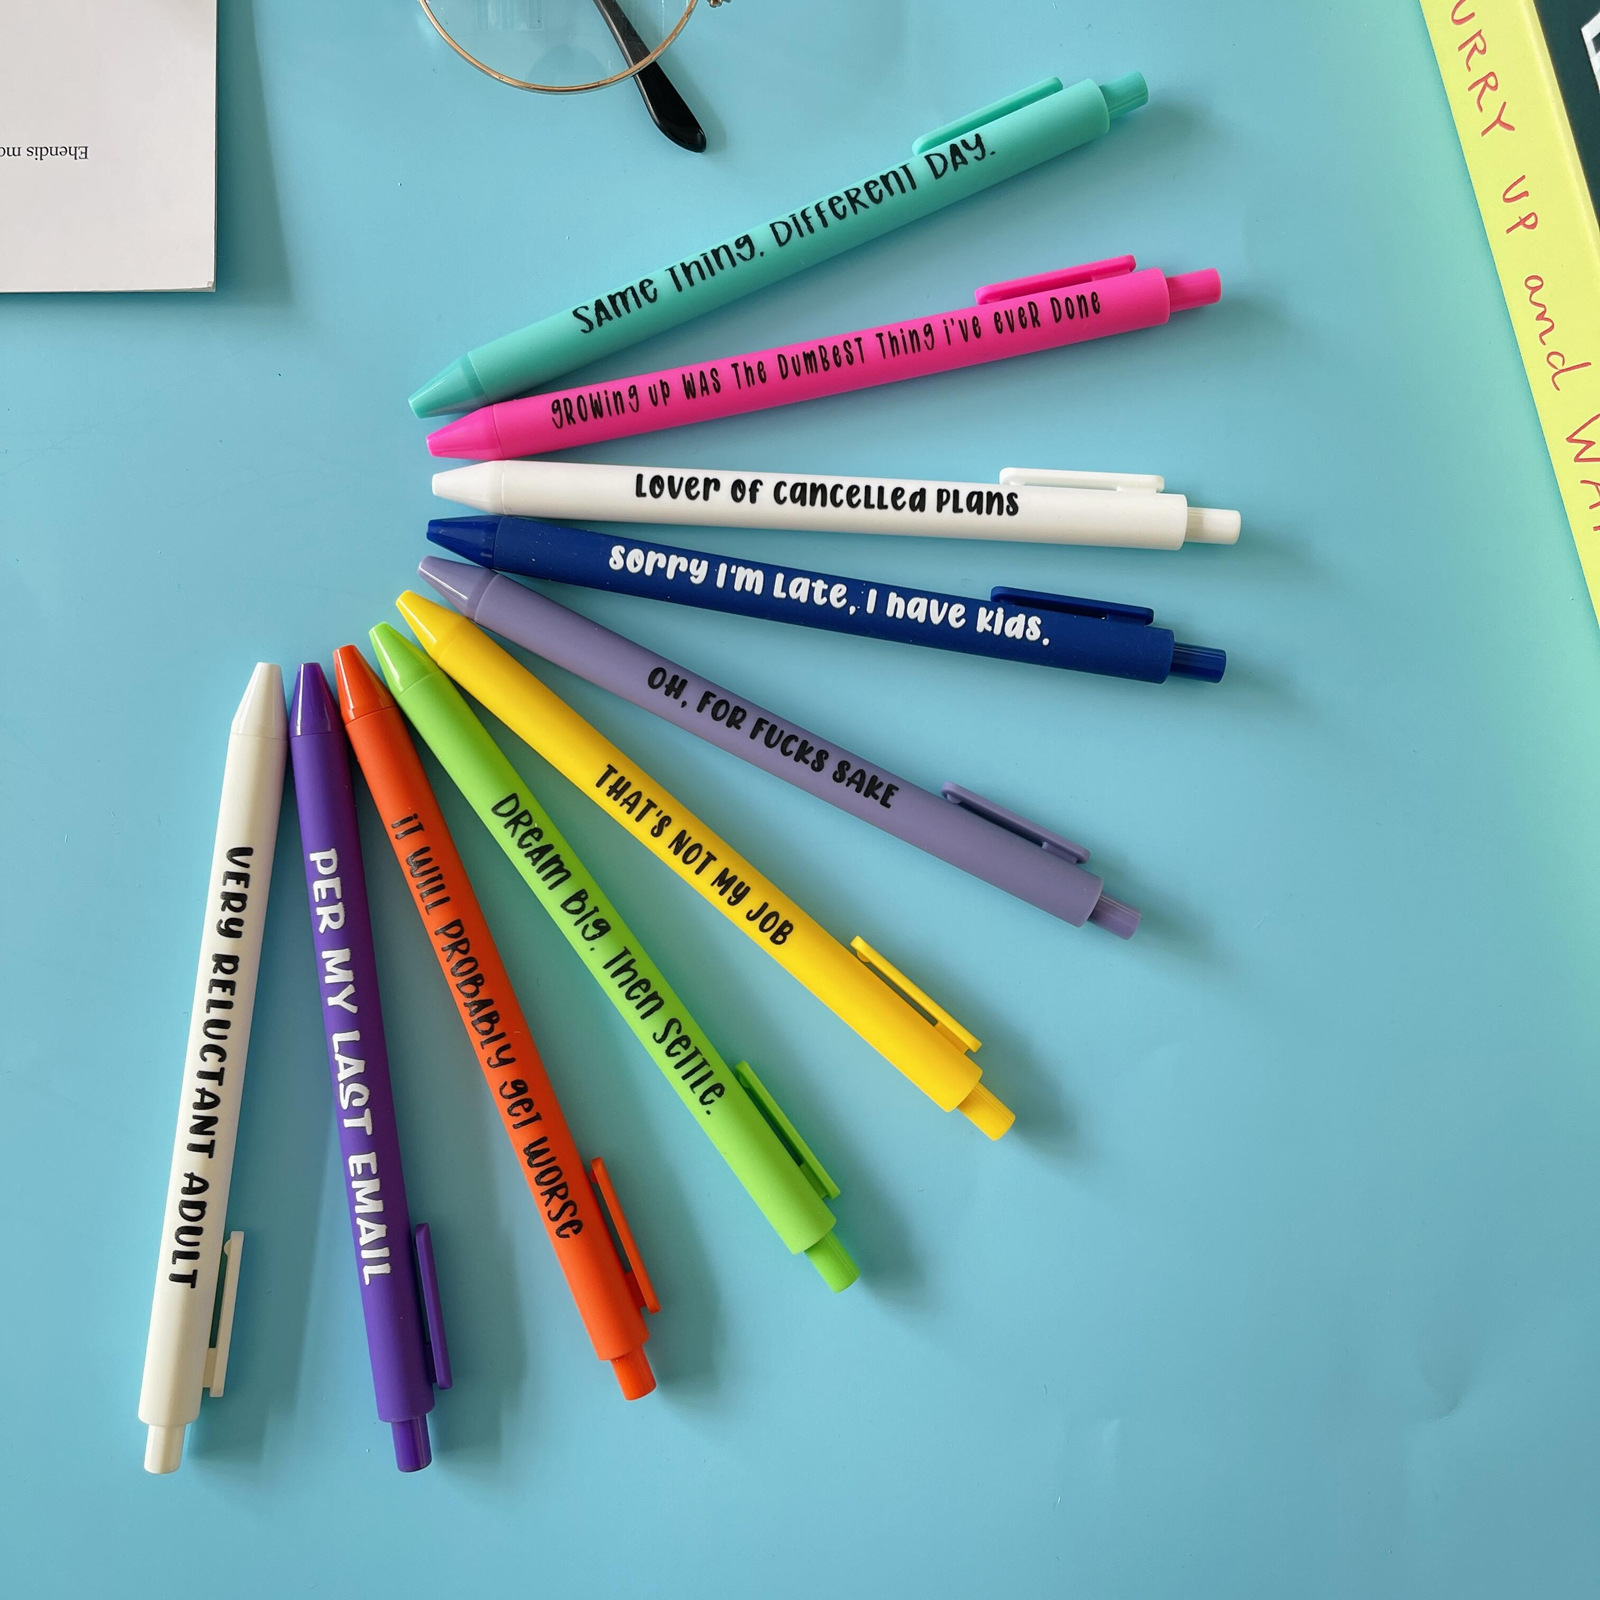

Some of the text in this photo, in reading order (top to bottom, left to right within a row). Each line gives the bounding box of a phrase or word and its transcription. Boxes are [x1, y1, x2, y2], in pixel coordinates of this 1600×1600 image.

[26, 146, 88, 160] Ehendis
[1502, 174, 1539, 234] UP
[1524, 275, 1592, 391] and
[681, 367, 721, 400] WAS
[716, 562, 764, 596] I'm
[866, 588, 876, 614] I
[886, 592, 966, 629] have
[696, 690, 747, 730] FOR
[749, 717, 829, 772] FUCKS
[832, 760, 899, 809] SAKE
[595, 763, 672, 838] THAT'S
[667, 829, 717, 876] NOT
[745, 901, 794, 946] JOB
[186, 953, 241, 1160] RELUCTANT
[309, 847, 393, 1286] PER MY LAST EMAIL
[168, 1171, 210, 1289] ADULT
